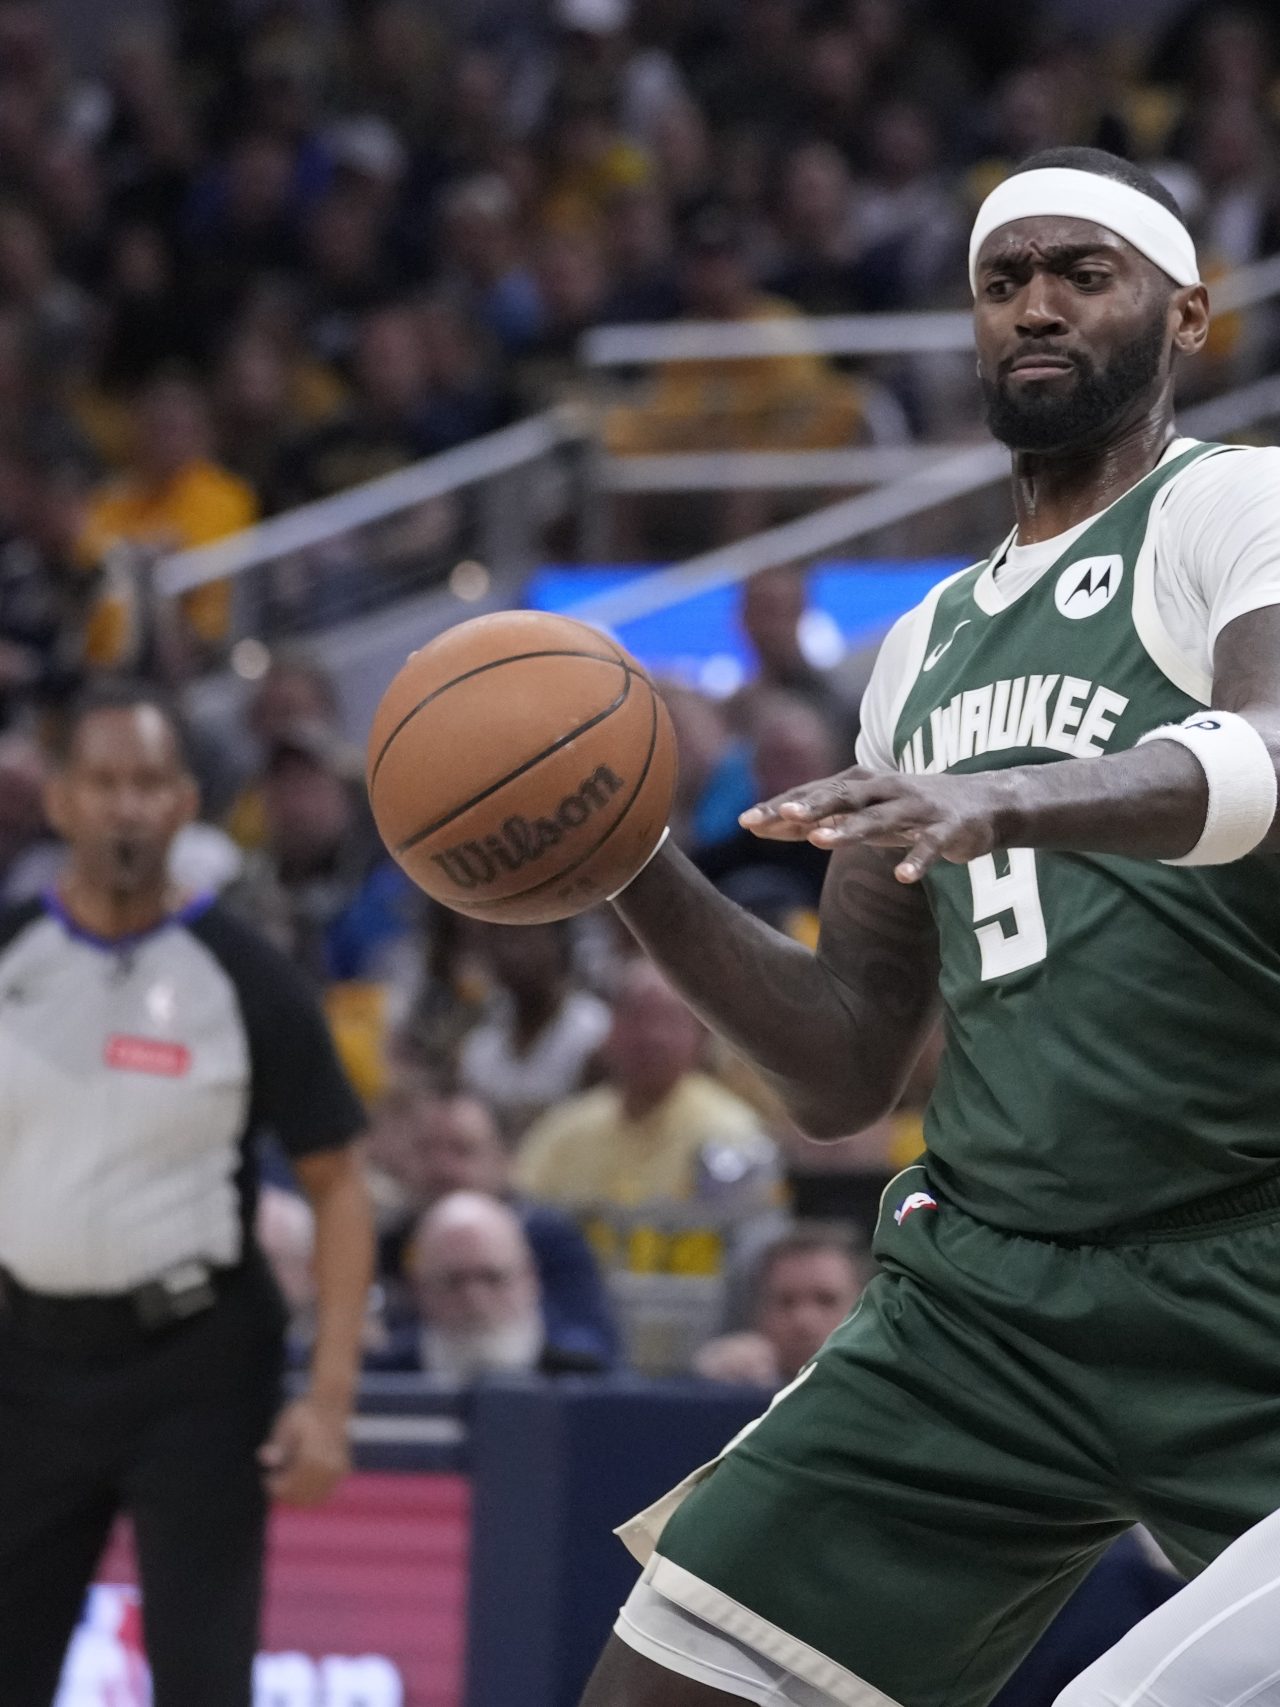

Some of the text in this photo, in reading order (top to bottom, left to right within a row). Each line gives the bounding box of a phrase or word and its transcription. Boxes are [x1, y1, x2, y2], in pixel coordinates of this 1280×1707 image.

[899, 673, 1130, 777] ILWAUKEE
[429, 763, 624, 888] Wilson
[967, 847, 1048, 982] 9
